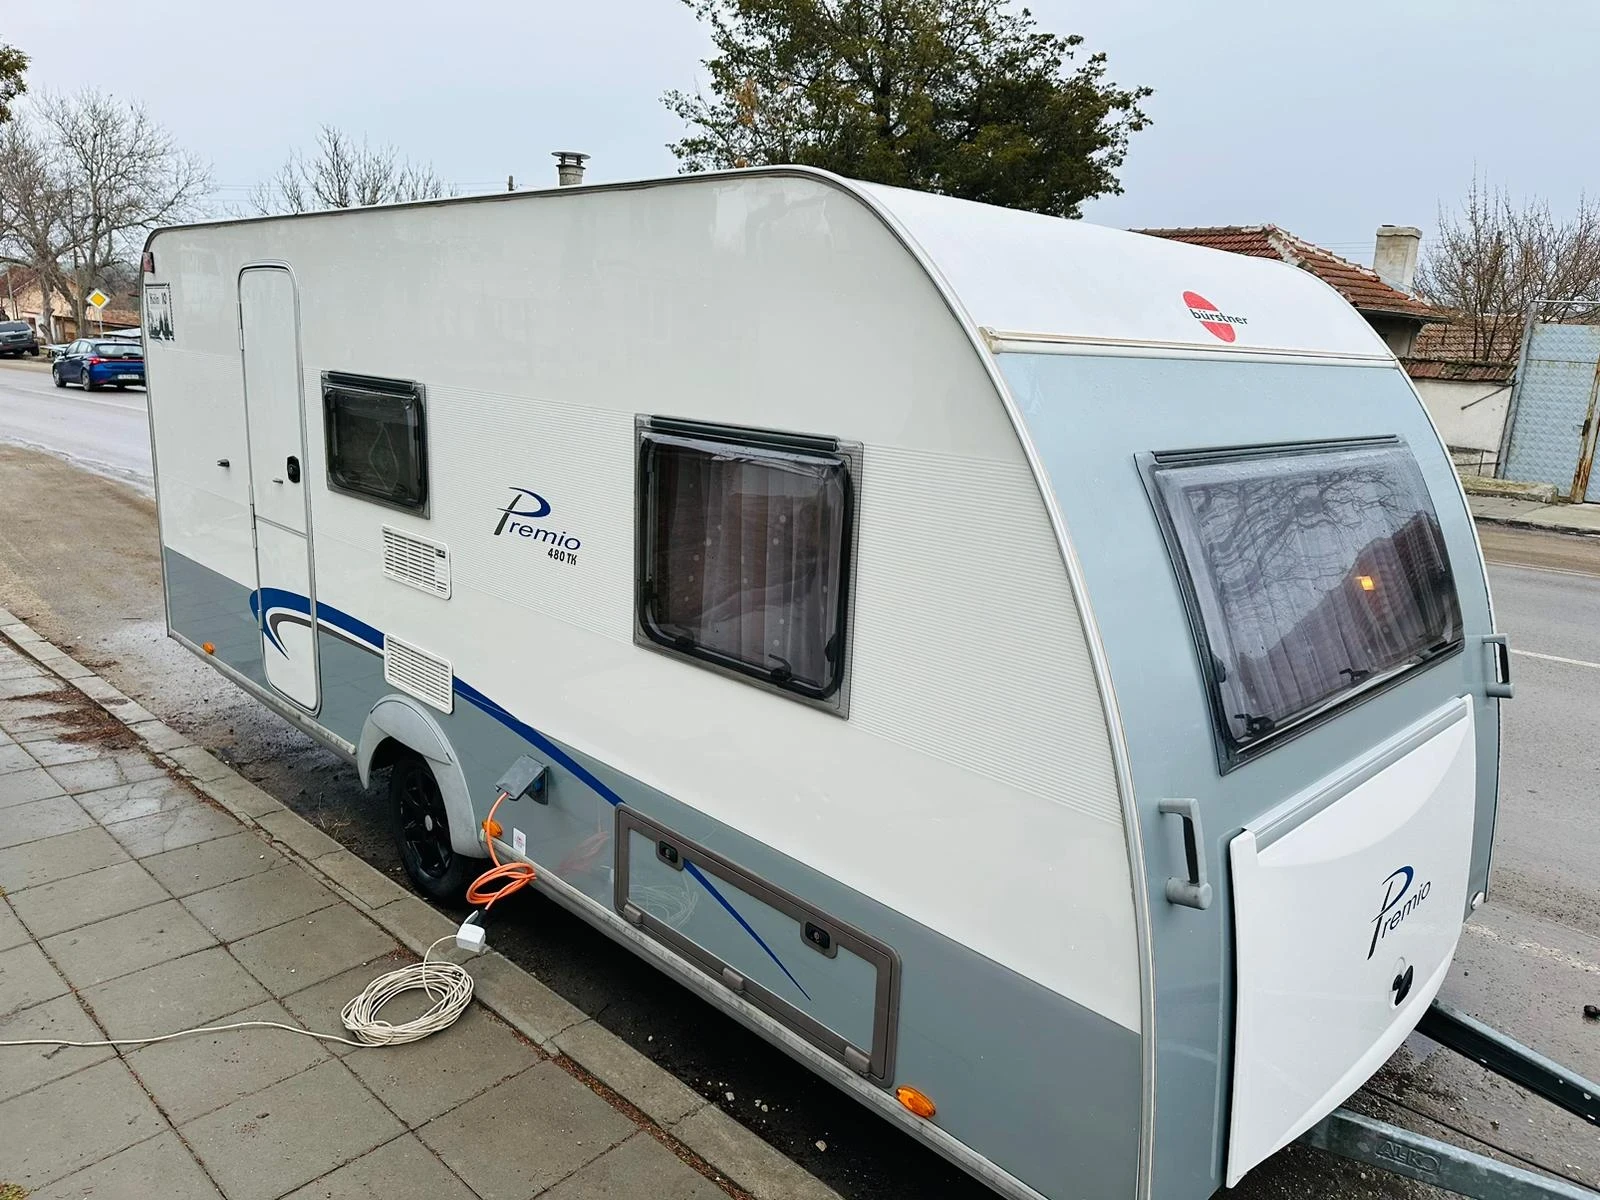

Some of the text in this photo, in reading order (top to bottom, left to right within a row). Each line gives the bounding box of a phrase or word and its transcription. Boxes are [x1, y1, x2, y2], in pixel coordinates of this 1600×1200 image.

[1189, 308, 1248, 325] bürstner
[494, 486, 581, 551] Premio
[547, 548, 578, 566] 480 TK
[1367, 865, 1431, 960] Premio
